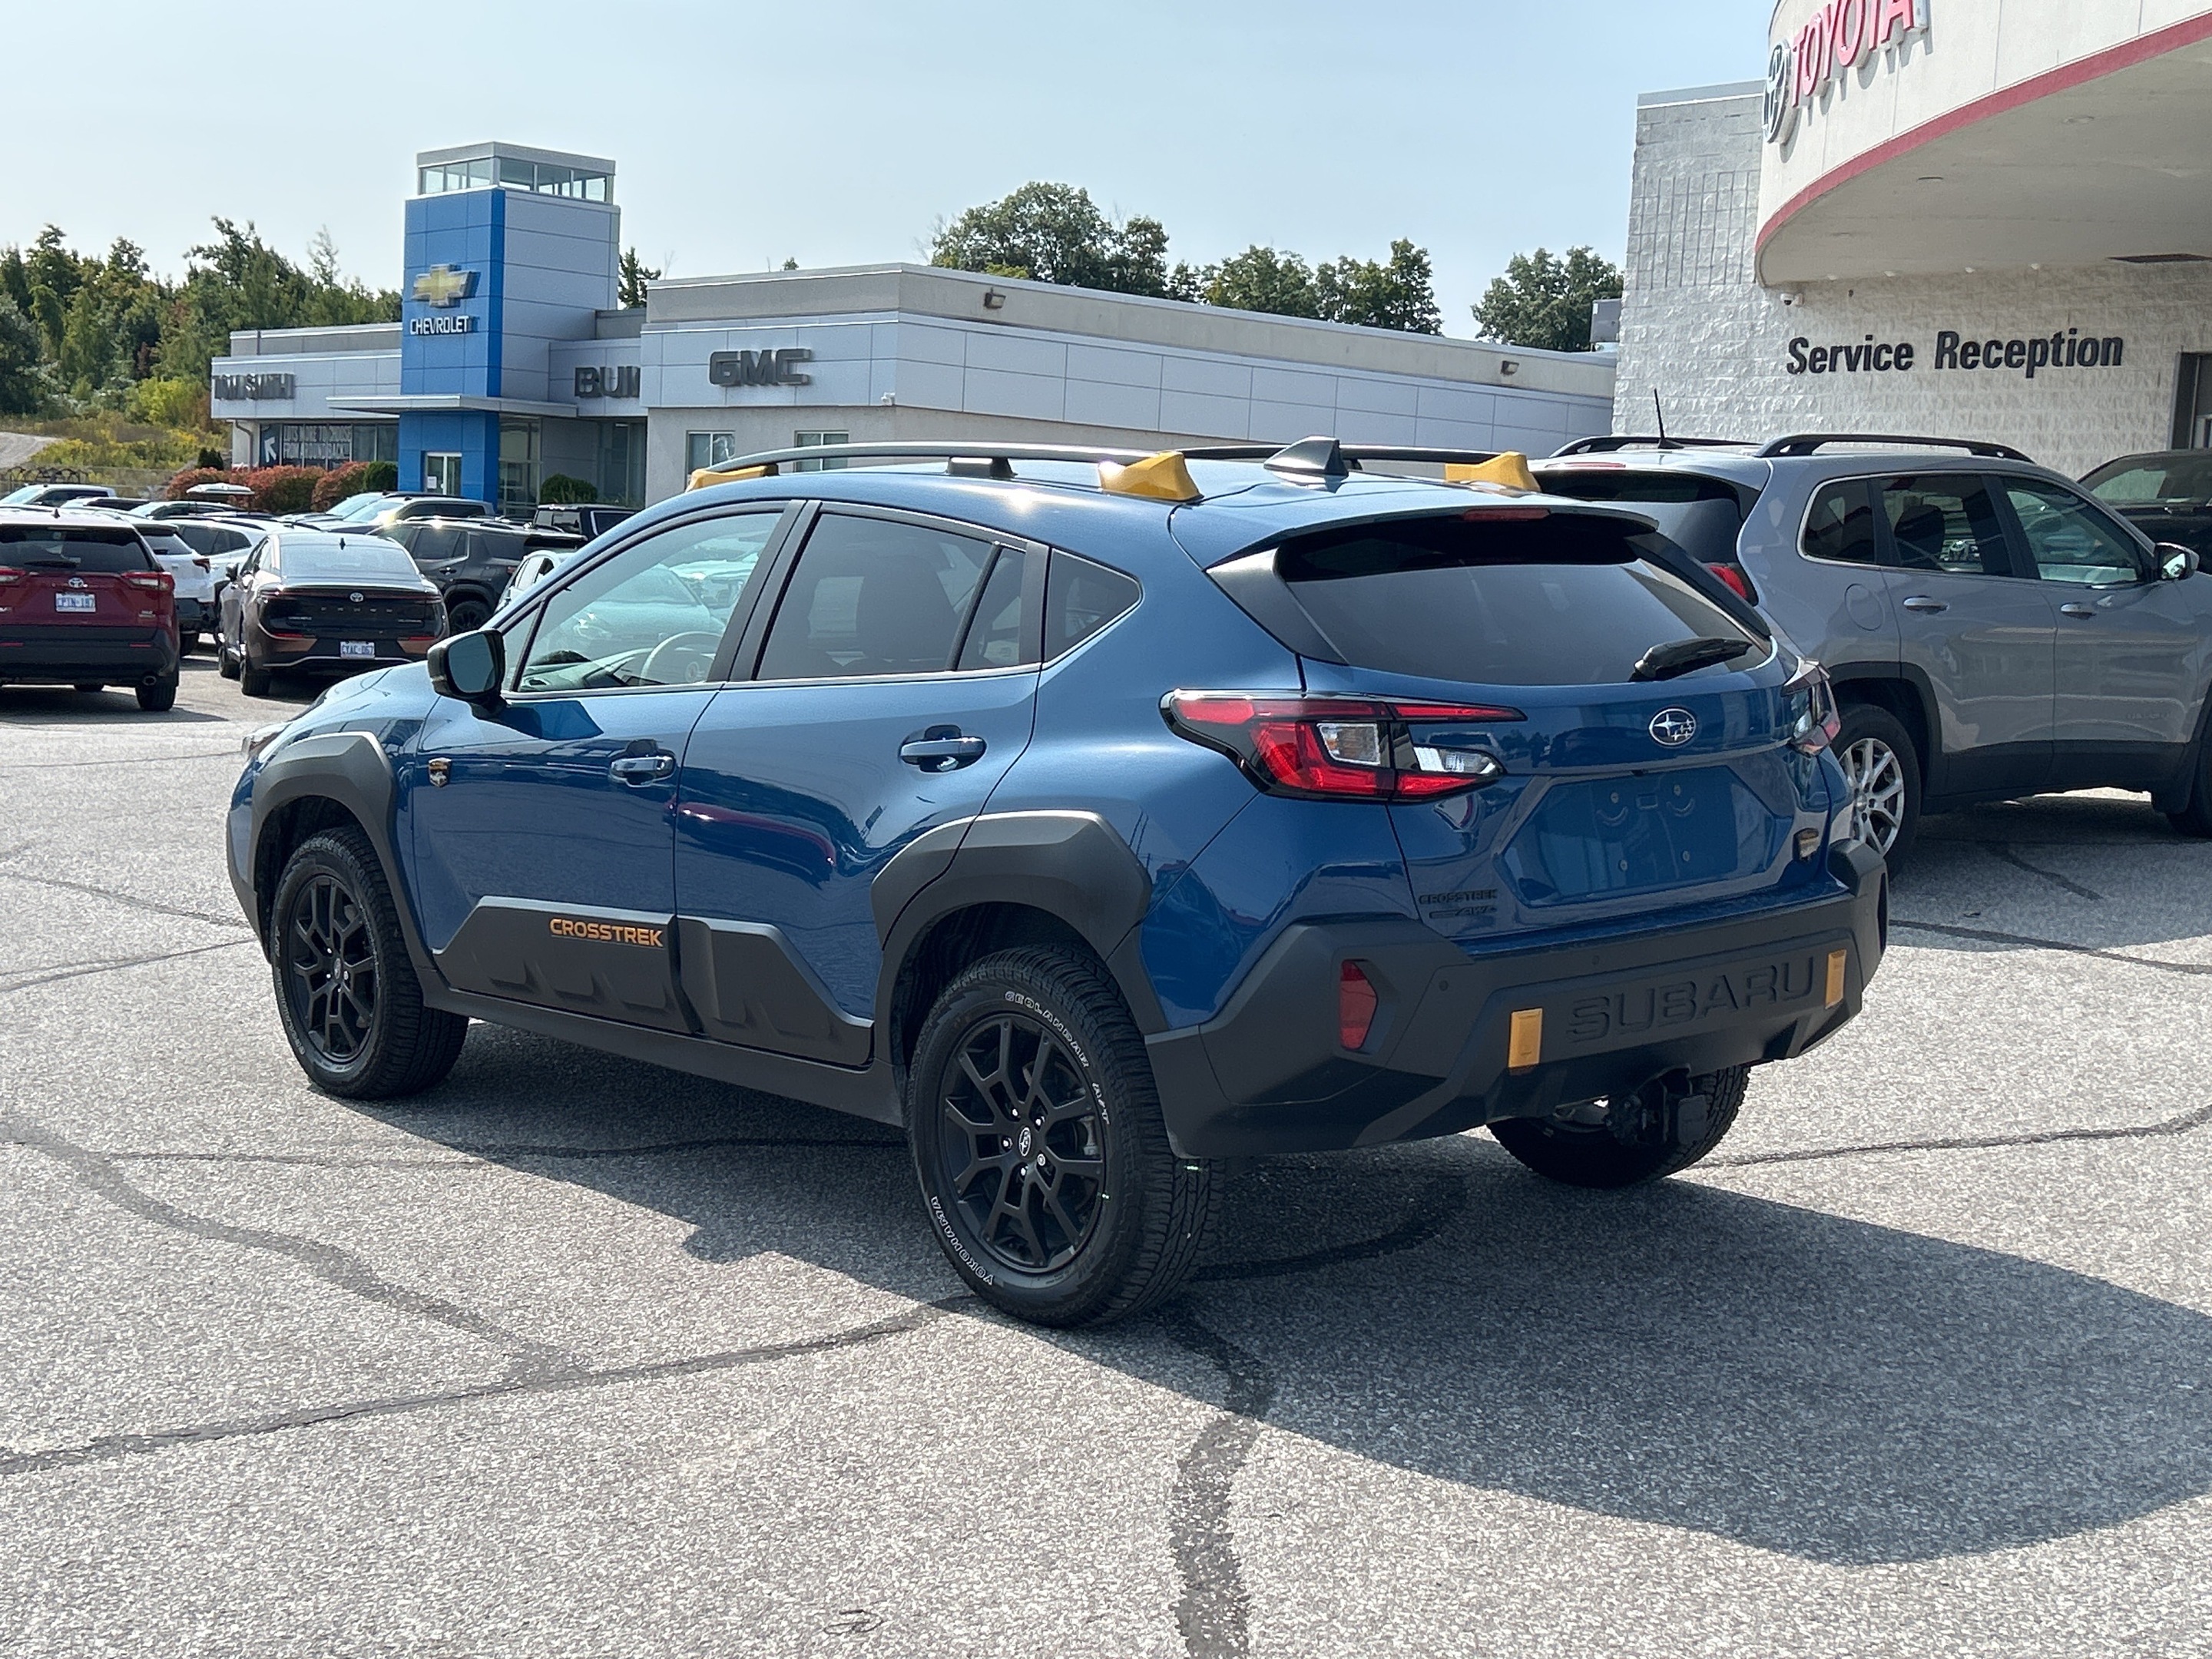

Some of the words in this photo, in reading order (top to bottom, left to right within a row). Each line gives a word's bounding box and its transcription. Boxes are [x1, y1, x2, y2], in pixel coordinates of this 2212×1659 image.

[409, 315, 469, 335] CHEVROLET
[709, 348, 811, 386] GMC
[1786, 334, 1915, 376] Service
[1934, 328, 2124, 379] Reception
[575, 366, 641, 398] BUI
[1419, 888, 1498, 905] CROSSTREK
[549, 918, 664, 948] CROSSTREK
[1566, 956, 1814, 1043] SUBARU
[1005, 990, 1090, 1068] GEOLANDAR
[931, 1196, 995, 1286] YOKOHAMA
